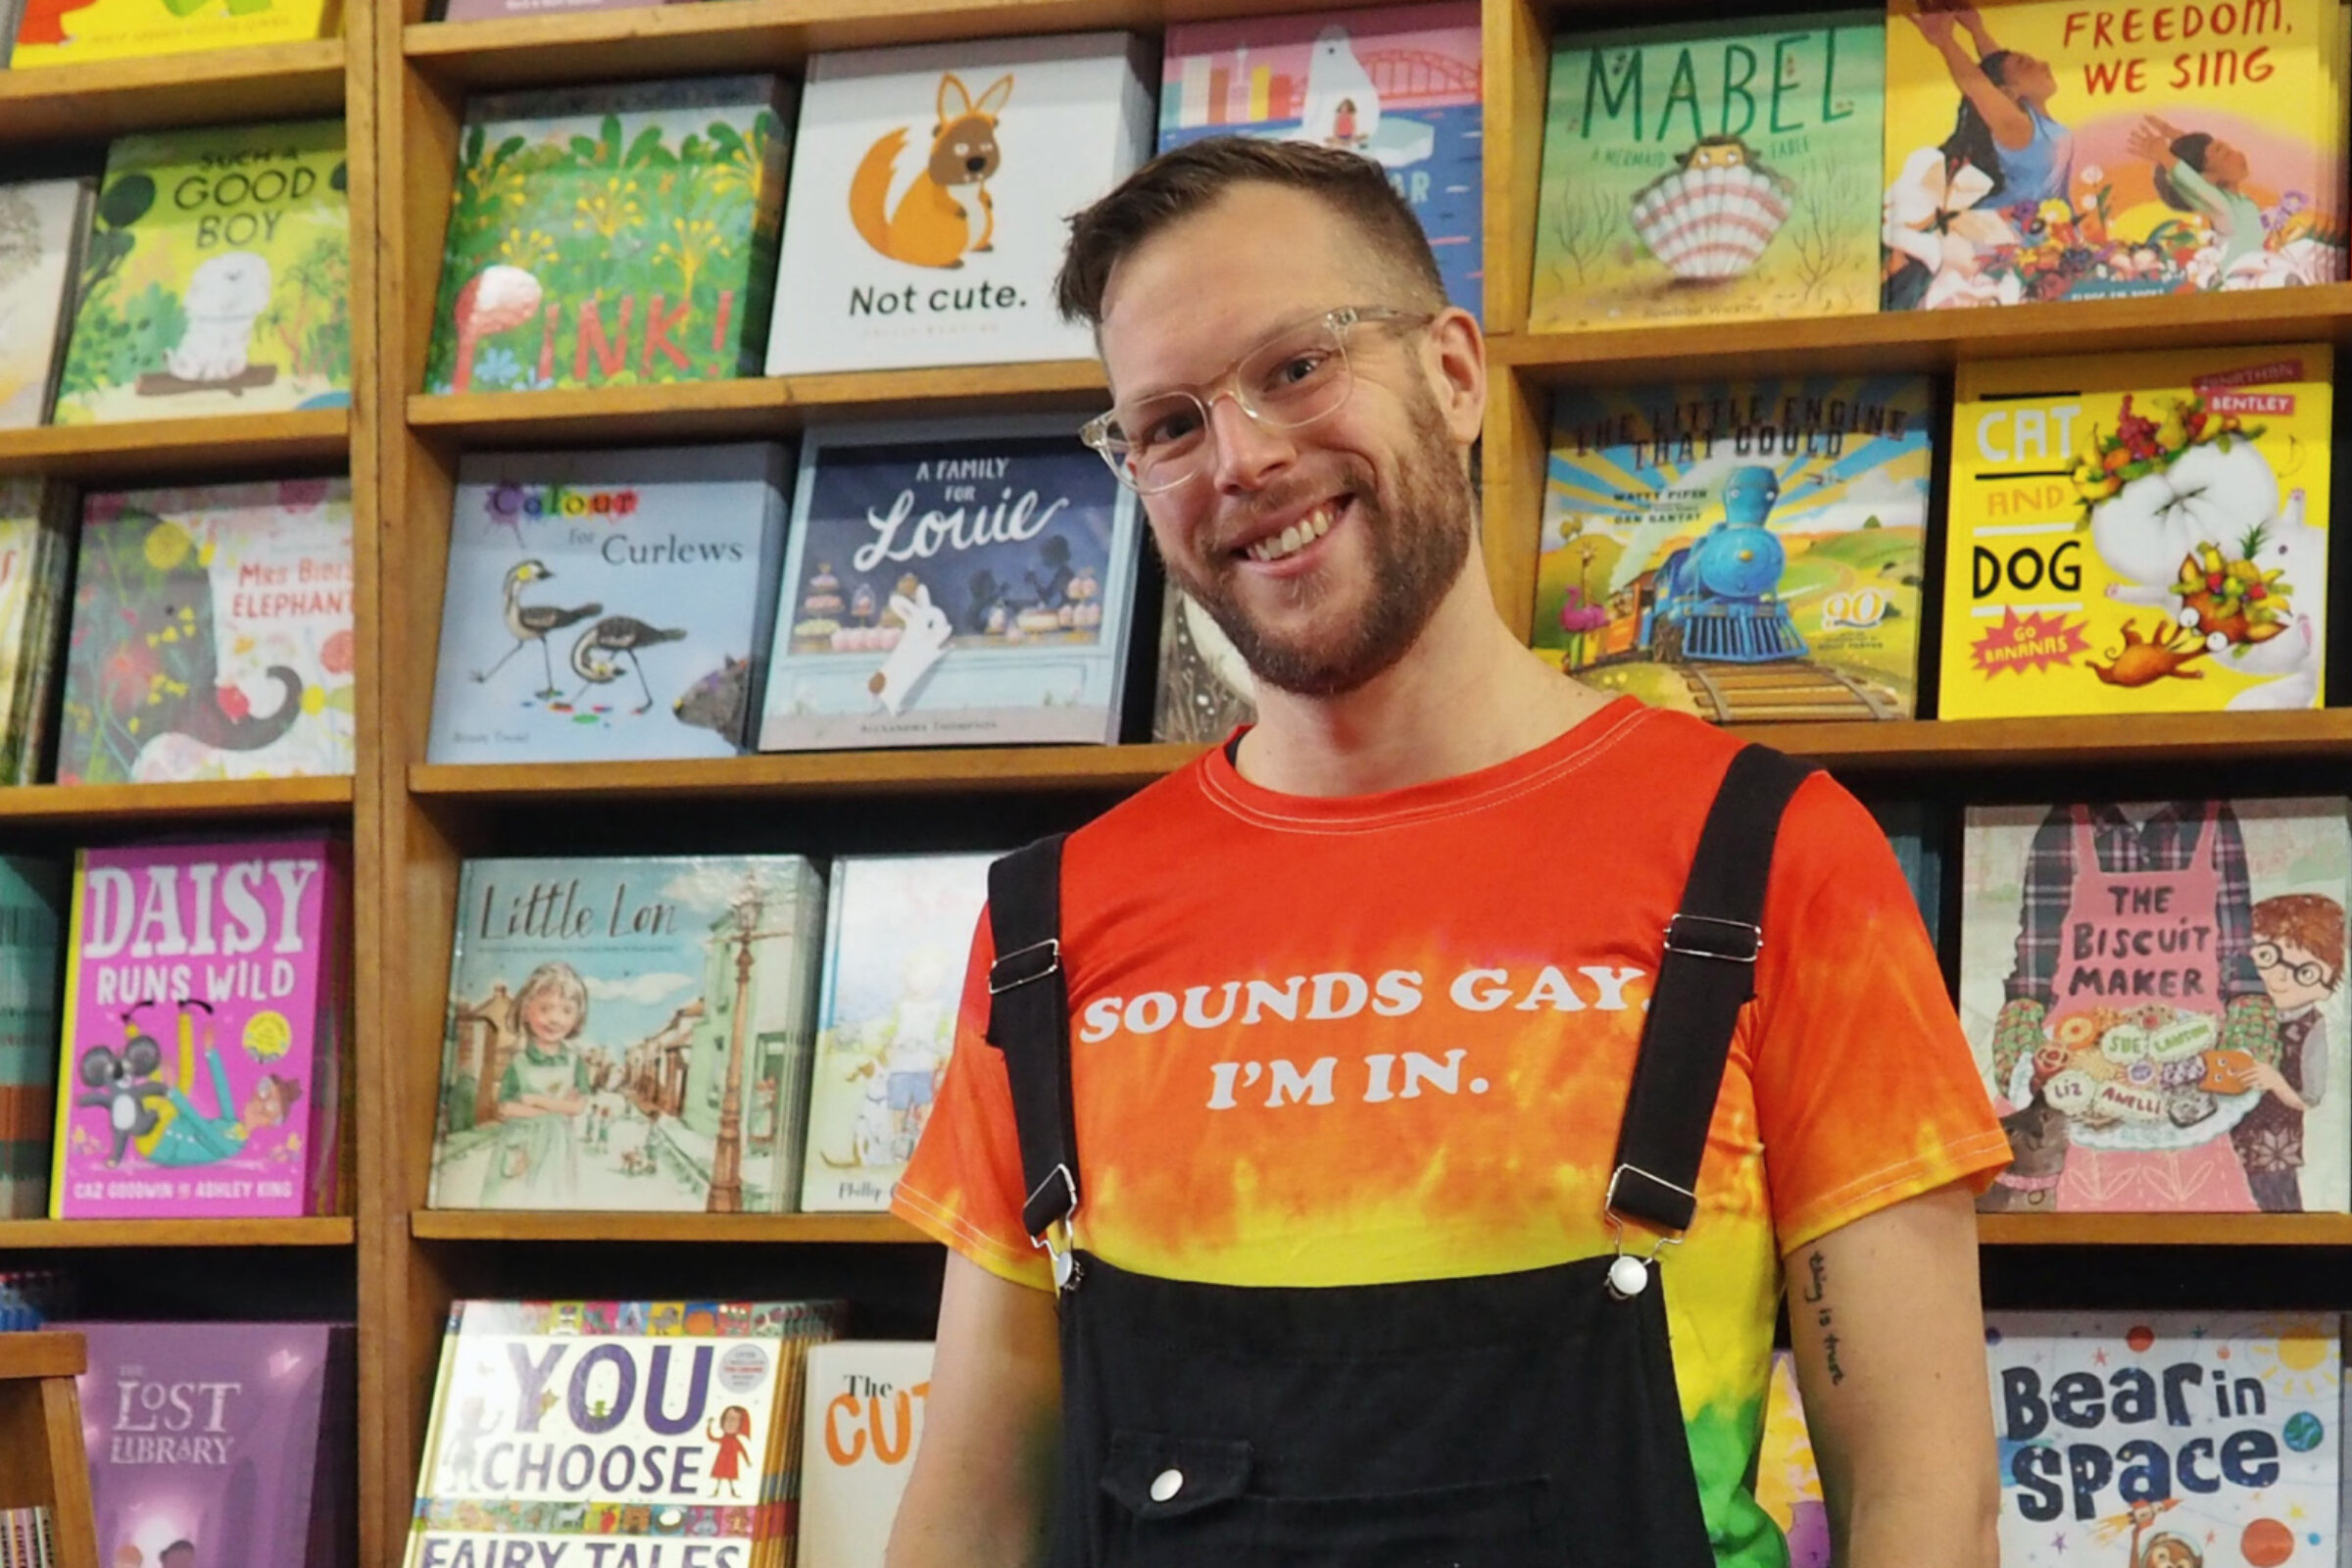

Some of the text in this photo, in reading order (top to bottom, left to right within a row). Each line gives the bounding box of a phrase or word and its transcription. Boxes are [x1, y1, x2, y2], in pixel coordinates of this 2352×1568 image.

[1580, 27, 1855, 143] MABEL
[2083, 45, 2275, 95] WE SING
[173, 165, 317, 211] GOOD
[197, 210, 283, 250] BOY
[849, 279, 1028, 318] Not cute.
[2212, 395, 2290, 412] BENTLEY
[1634, 424, 1843, 471] THAT COULD
[1977, 405, 2081, 464] CAT
[916, 457, 1011, 482] A FAMILY
[490, 483, 636, 516] Colour
[944, 485, 975, 502] FOR
[1986, 484, 2065, 518] AND
[600, 535, 745, 566] Curlews
[854, 488, 1070, 572] Louie
[1973, 541, 2082, 600] DOG
[1984, 636, 2069, 664] BANANAS
[2013, 624, 2037, 642] GO
[82, 858, 318, 959] DAISY
[477, 878, 680, 943] Little Lon
[2106, 885, 2176, 915] THE
[2072, 916, 2213, 962] BISCUIT
[97, 958, 297, 1007] RUNS WILD
[1078, 964, 1650, 1044] SOUNDS GAY.
[2067, 965, 2206, 1000] MAKER
[2108, 1034, 2142, 1054] SUE
[1205, 1048, 1491, 1111] I'M IN.
[112, 1380, 242, 1433] LOST
[506, 1342, 715, 1436] YOU
[843, 1374, 893, 1398] The
[2001, 1361, 2267, 1441] Bear in
[110, 1435, 235, 1465] LIBRARY
[481, 1444, 704, 1495] CHOOSE
